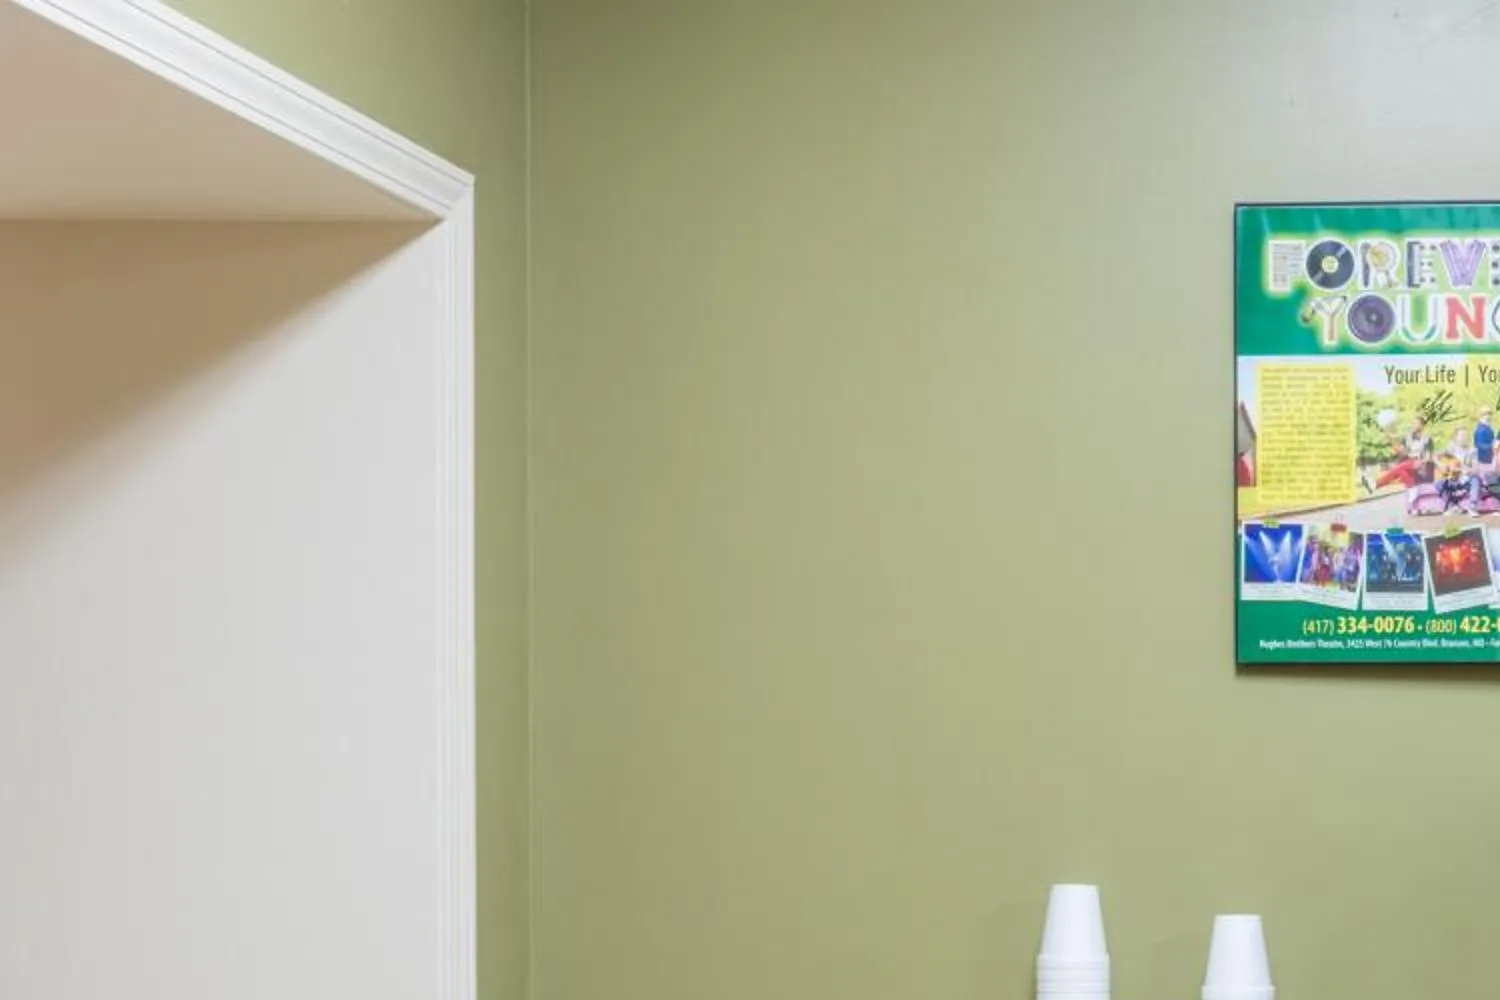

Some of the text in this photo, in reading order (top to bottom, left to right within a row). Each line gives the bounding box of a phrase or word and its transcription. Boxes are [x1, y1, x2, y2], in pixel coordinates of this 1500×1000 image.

[1384, 365, 1420, 384] Your
[1425, 364, 1456, 384] Life
[1302, 619, 1335, 636] (417)
[1337, 616, 1415, 634] 334-0076
[1425, 618, 1457, 635] (800)
